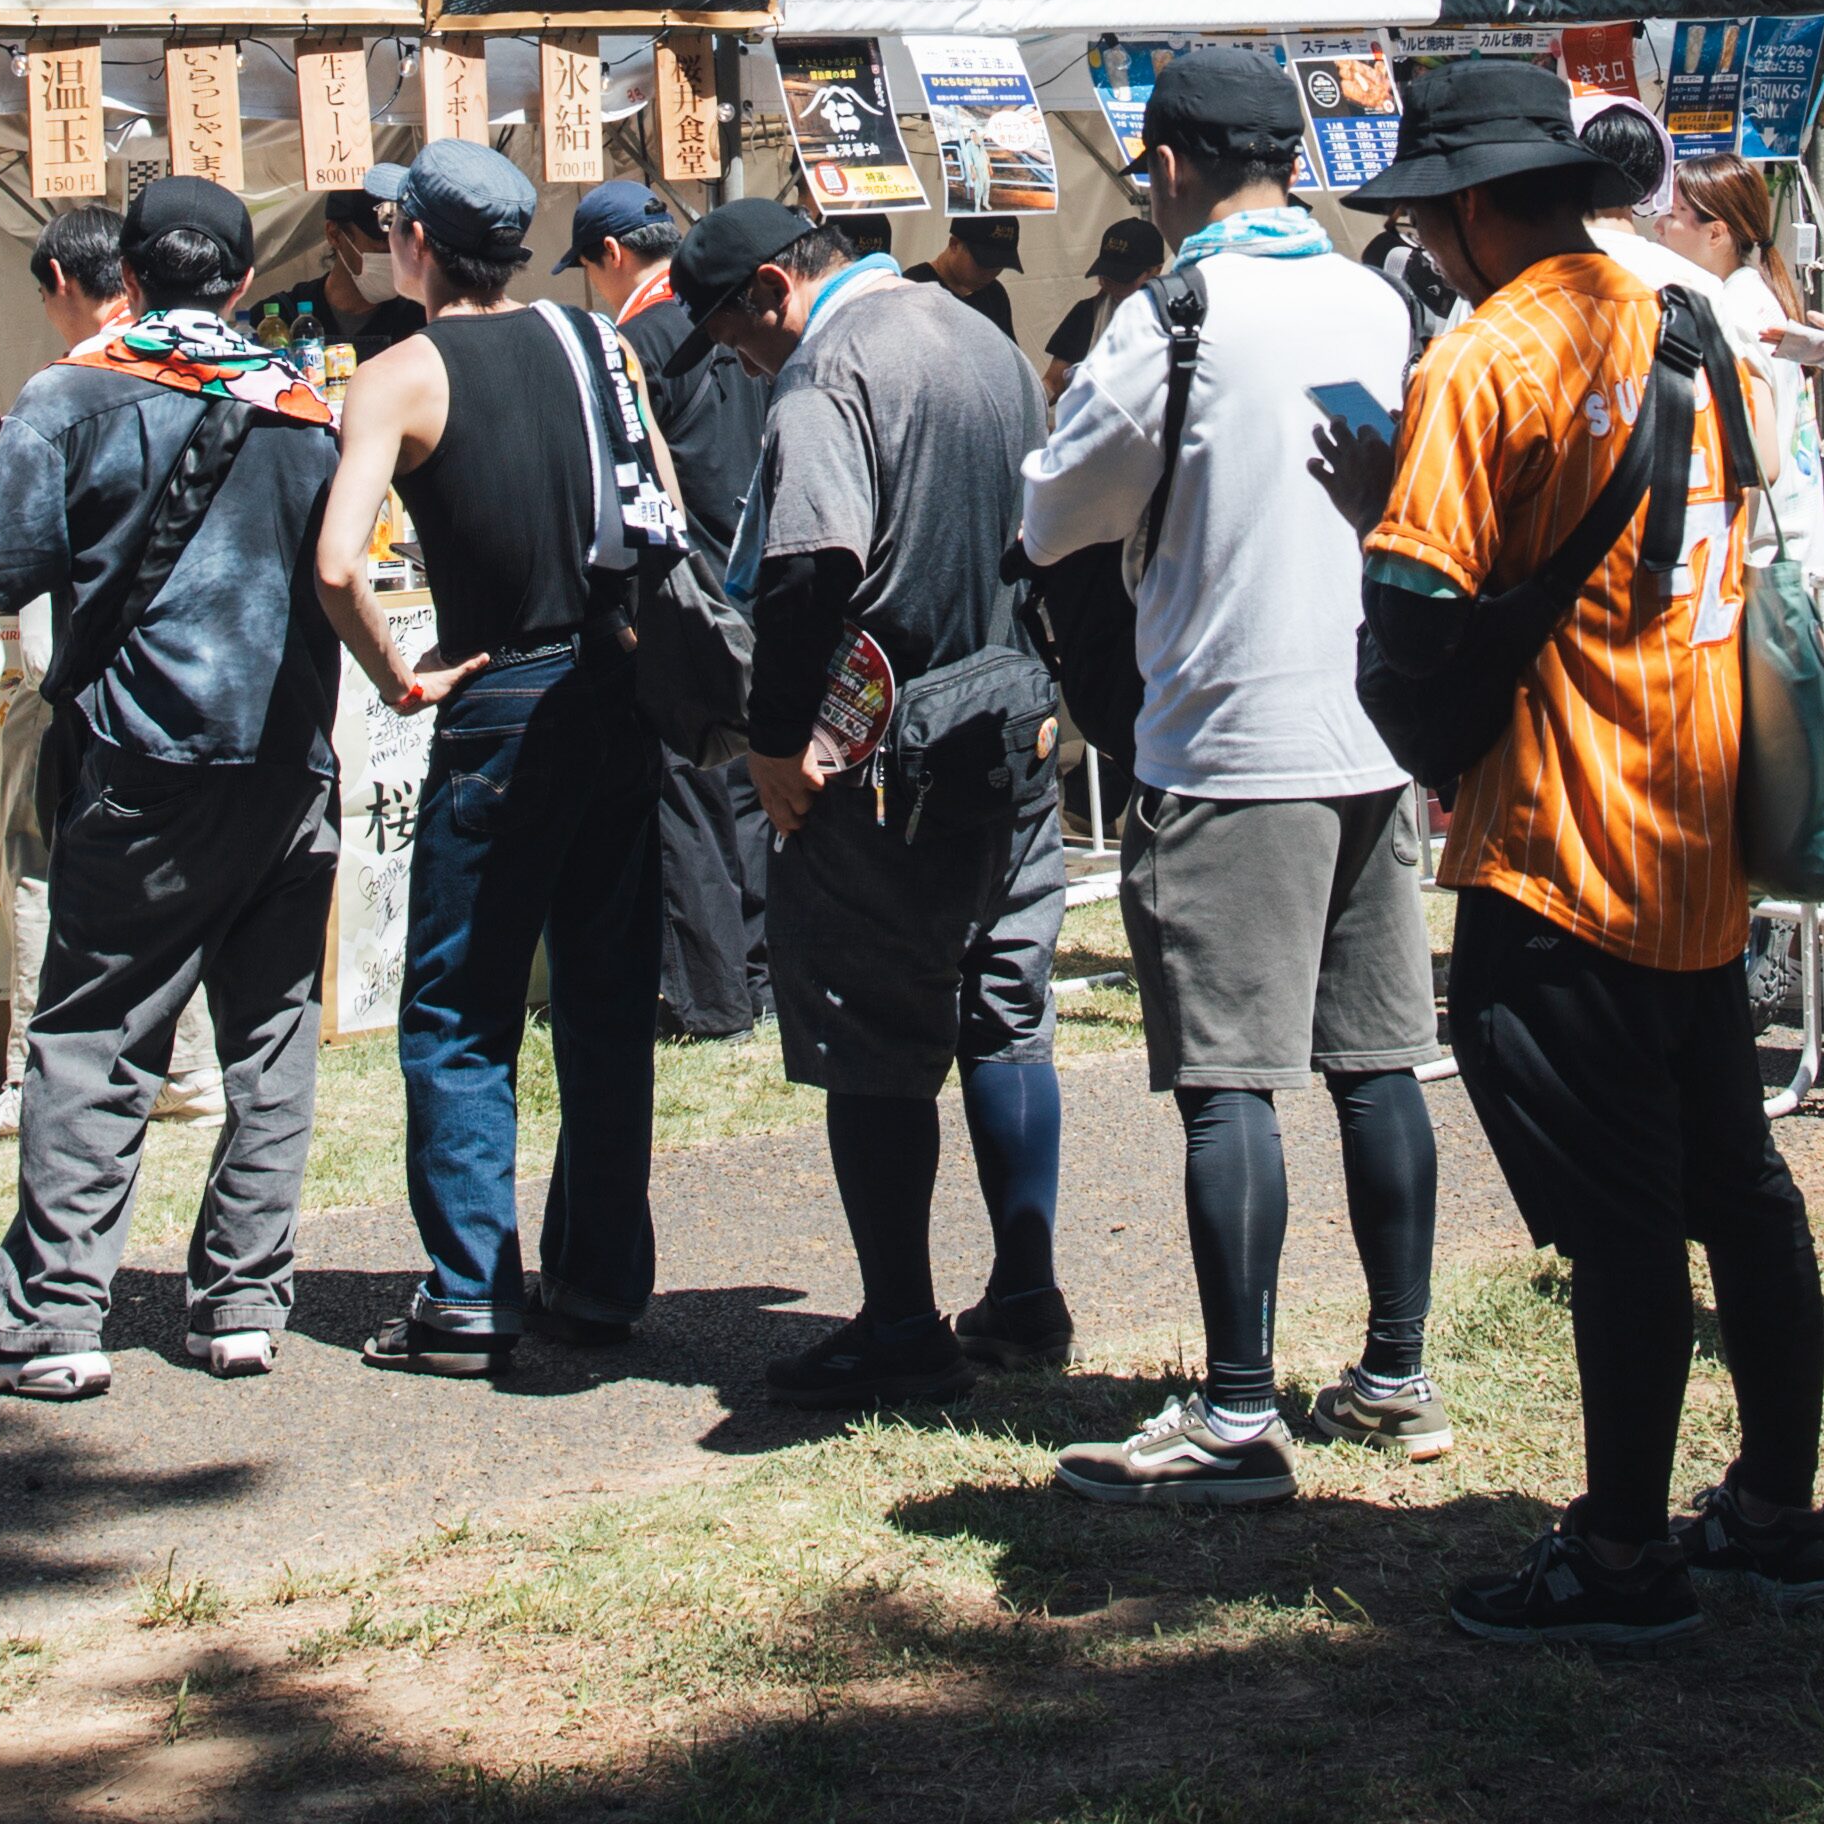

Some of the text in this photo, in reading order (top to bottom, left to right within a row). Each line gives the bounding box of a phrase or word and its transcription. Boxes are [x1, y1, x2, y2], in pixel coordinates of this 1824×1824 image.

[1301, 39, 1353, 55] ステーキ
[1478, 32, 1534, 48] カルビ焼肉
[1754, 44, 1813, 58] ドリンクのみの
[1576, 60, 1628, 87] 注文口
[1750, 83, 1801, 100] DRINKS
[319, 54, 352, 163] 生ビール
[553, 53, 592, 152] 氷結
[1757, 103, 1790, 120] ONLY
[40, 58, 93, 167] 温玉
[672, 52, 708, 175] 桜井食堂
[315, 166, 367, 184] 800円
[554, 160, 597, 177] 700円
[43, 173, 98, 193] 150円
